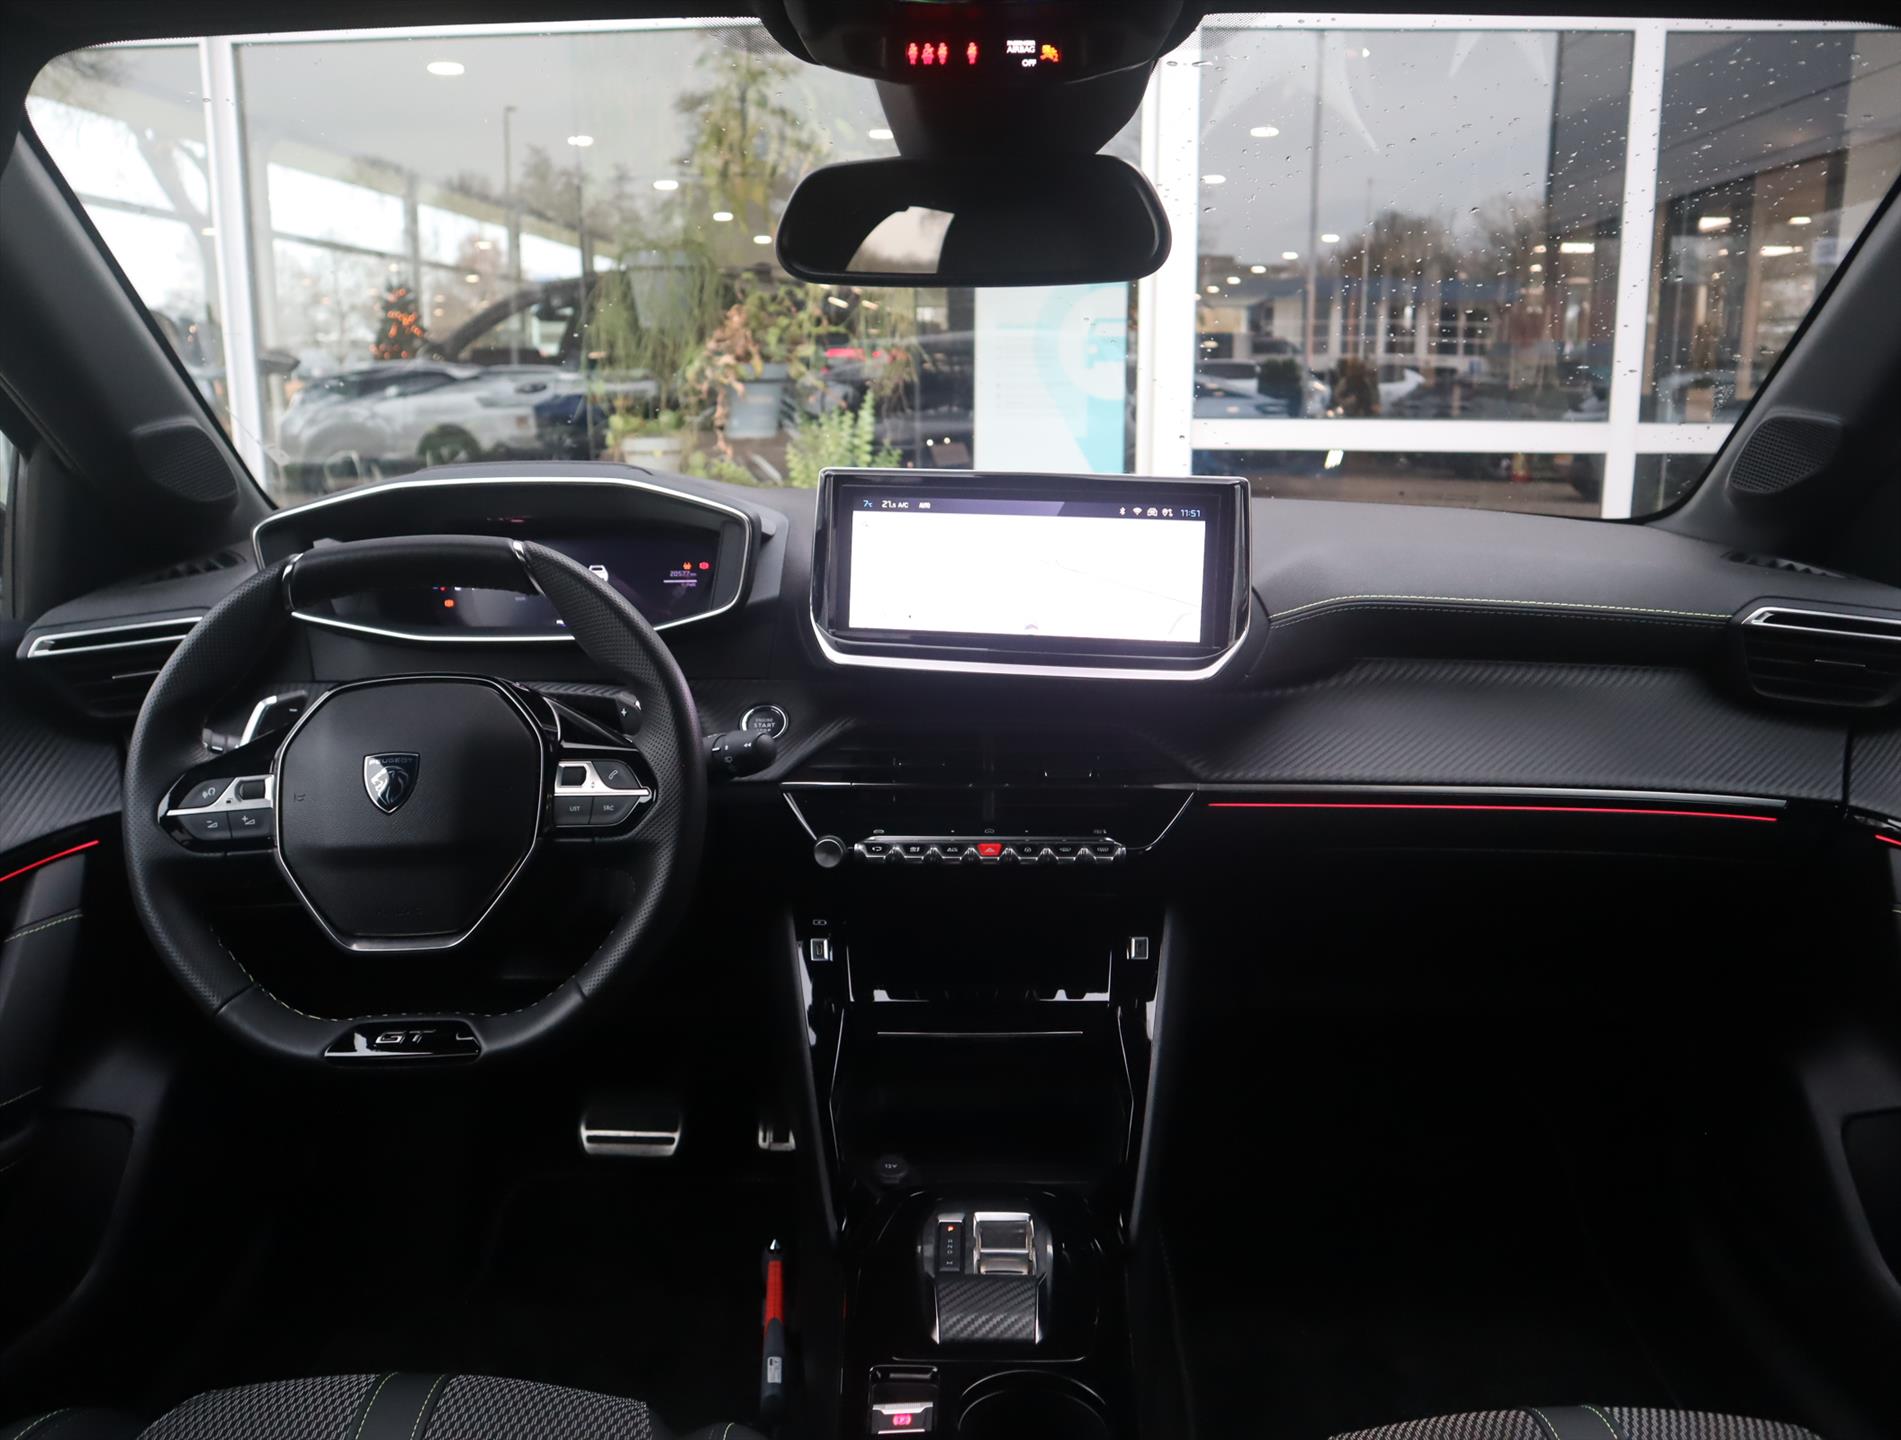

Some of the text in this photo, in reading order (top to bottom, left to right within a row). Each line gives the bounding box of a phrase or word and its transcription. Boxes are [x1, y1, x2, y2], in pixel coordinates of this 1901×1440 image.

[1006, 45, 1036, 54] AIRBAG
[1021, 58, 1037, 67] OFF
[1180, 509, 1201, 518] 11:51
[375, 1028, 437, 1044] GT
